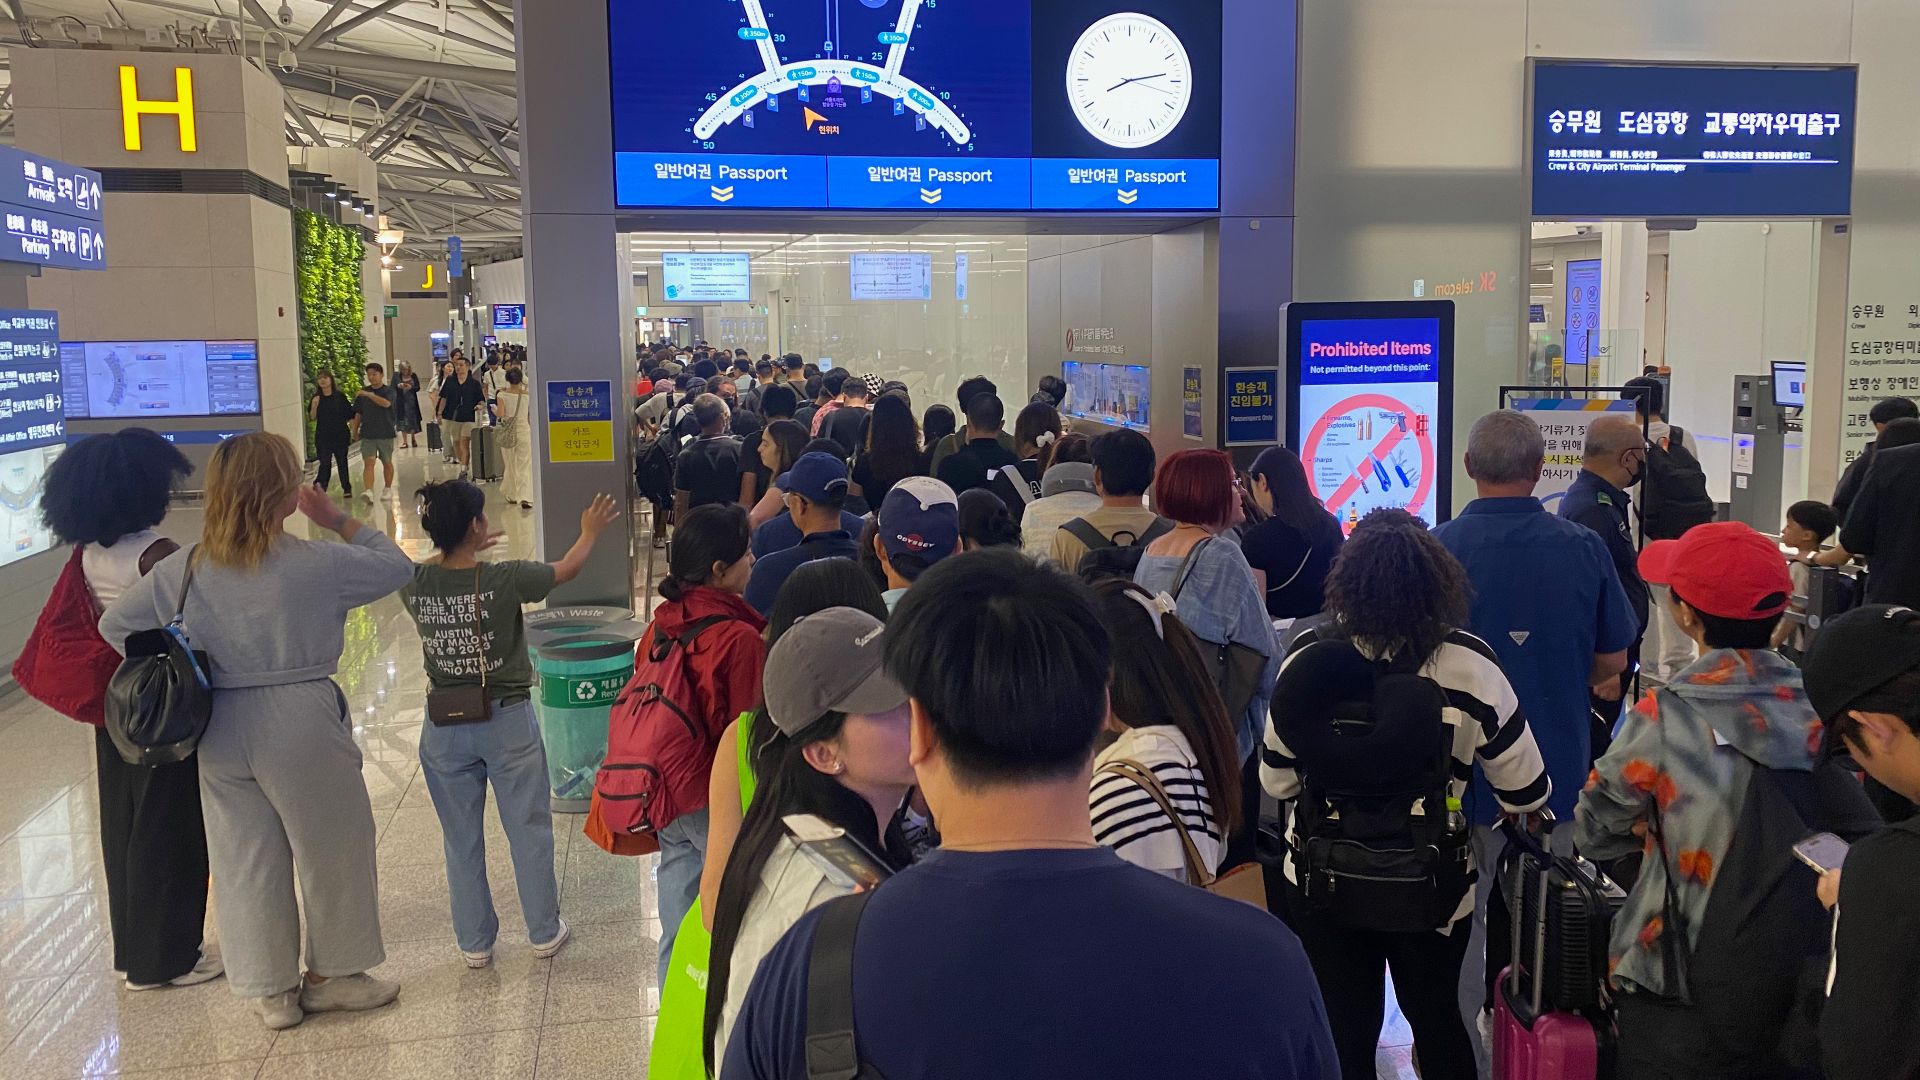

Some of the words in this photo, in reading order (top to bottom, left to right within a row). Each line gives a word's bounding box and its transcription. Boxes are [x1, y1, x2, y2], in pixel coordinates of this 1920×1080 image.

[749, 30, 766, 38] 350m
[774, 34, 786, 43] 30
[871, 52, 883, 61] 25
[797, 69, 814, 78] 150m
[861, 71, 877, 81] 150m
[704, 93, 717, 101] 45
[799, 89, 807, 98] 4
[863, 90, 870, 99] 3
[939, 92, 951, 100] 10
[769, 97, 777, 107] 5
[895, 102, 902, 111] 2
[119, 65, 197, 152] H
[745, 113, 751, 123] 6
[918, 117, 924, 126] 1
[1548, 109, 1602, 134] 승무원
[1618, 111, 1689, 135] 도심공항
[1703, 112, 1841, 136] 교통약자우대출구
[818, 126, 840, 135] 현위치
[940, 131, 945, 139] 1
[703, 142, 715, 150] 50
[968, 143, 974, 151] 5
[654, 163, 712, 180] 일반여권
[718, 165, 788, 182] Passport
[1548, 162, 1568, 171] Crew
[1568, 162, 1575, 171] &
[1576, 162, 1591, 173] City
[1592, 163, 1618, 173] Airport
[1619, 163, 1650, 171] Terminal
[1650, 163, 1687, 173] Passenger
[867, 166, 922, 182] 일반여권
[928, 168, 993, 184] Passport
[1067, 168, 1119, 184] 일반여권
[1125, 169, 1187, 185] Passport
[28, 183, 55, 203] Arrivals
[51, 228, 77, 254] 주차장
[22, 237, 50, 260] Parking
[421, 264, 434, 289] J
[1852, 304, 1885, 319] 승무원
[1310, 341, 1388, 357] Prohibited
[1391, 341, 1432, 355] Items
[1310, 366, 1325, 374] Not
[1325, 365, 1363, 375] permitted
[1364, 364, 1393, 374] beyond
[1393, 363, 1408, 371] this
[1408, 363, 1431, 373] point:
[1235, 381, 1267, 395] 환송객
[1848, 377, 1881, 391] 보행상
[1886, 376, 1920, 391] 장애인
[1230, 395, 1273, 408] 진입불가
[1561, 439, 1581, 451] 위해
[1550, 454, 1560, 465] 시
[1542, 468, 1573, 480] 하시기
[896, 534, 935, 548] ODYSSEY
[410, 596, 417, 605] IF
[418, 596, 444, 606] Y'ALL
[420, 605, 450, 616] HERE,
[451, 605, 465, 615] I'D
[468, 603, 483, 613] B
[569, 609, 604, 618] Waste
[418, 615, 456, 625] CRYING
[434, 627, 473, 639] AUSTIN
[436, 659, 454, 669] HIS
